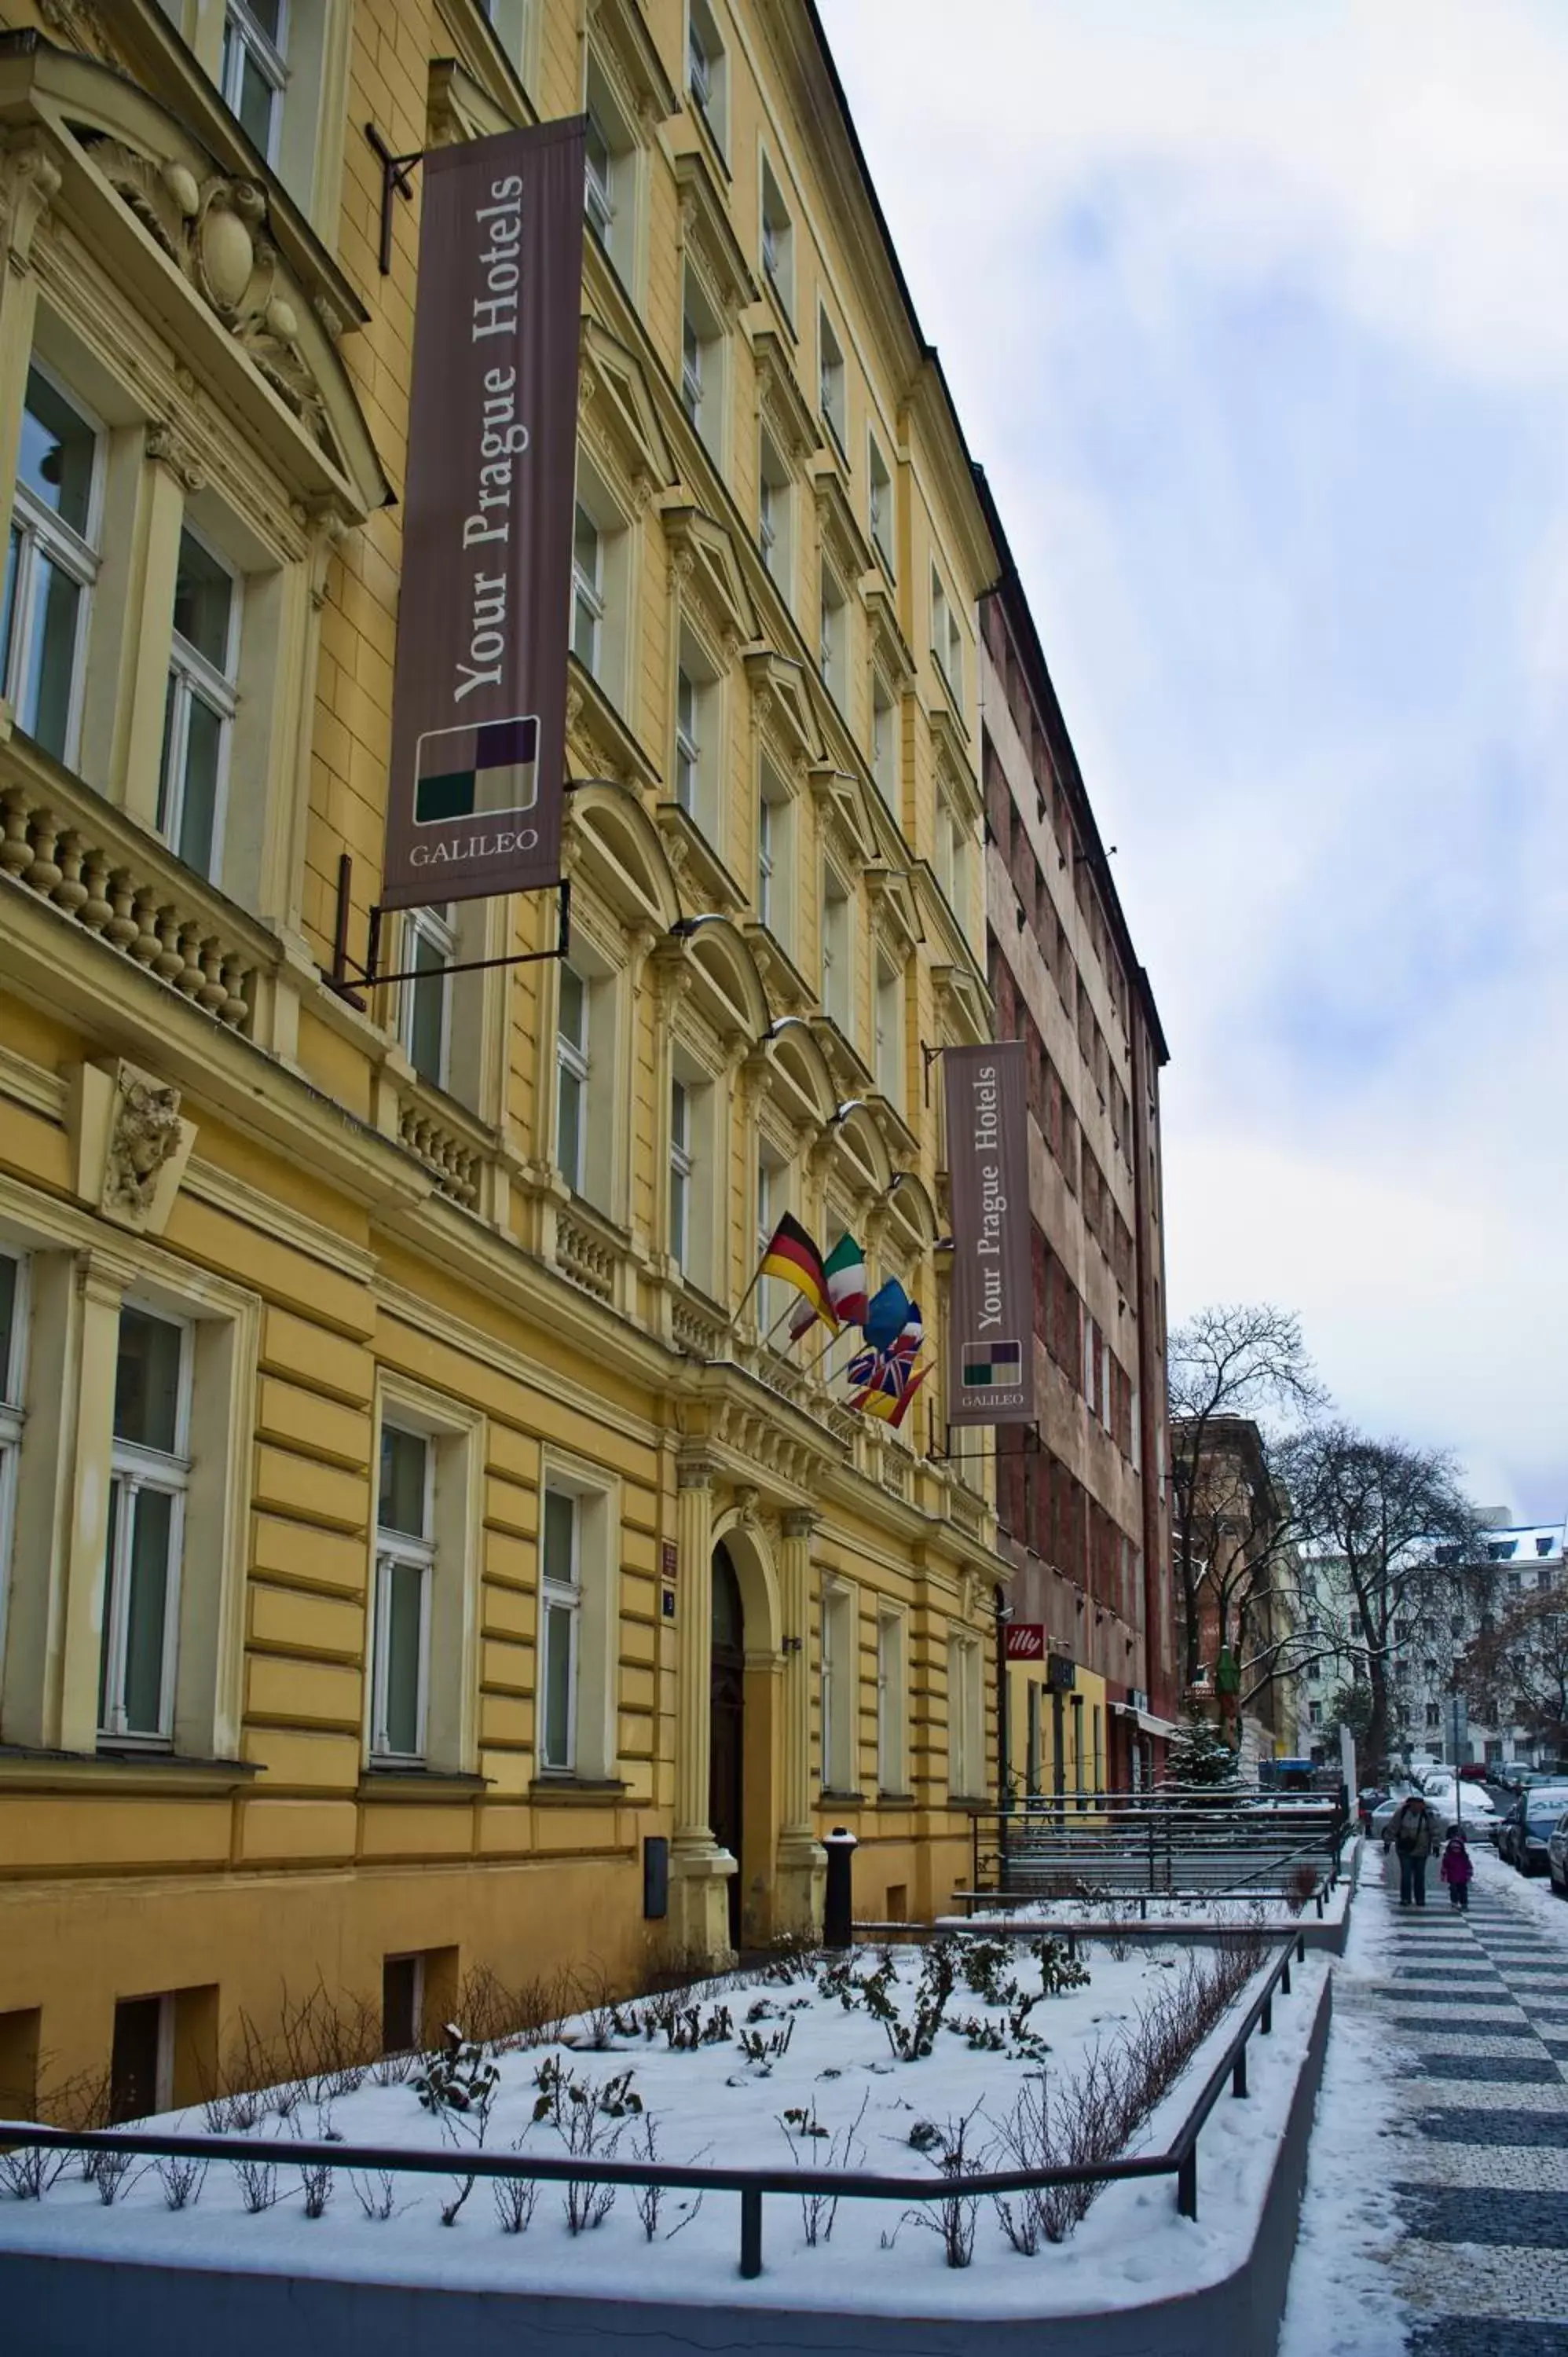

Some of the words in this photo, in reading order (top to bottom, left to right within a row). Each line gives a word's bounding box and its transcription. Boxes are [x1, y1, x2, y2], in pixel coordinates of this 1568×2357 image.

[473, 174, 522, 342] Hotels
[463, 366, 528, 549] Prague
[455, 573, 507, 703] Your
[409, 828, 539, 867] GALILEO
[973, 1066, 997, 1152] Hotels
[977, 1166, 1007, 1255] Prague
[977, 1267, 1002, 1330] Your
[962, 1393, 1024, 1407] GALILEO
[1008, 1629, 1041, 1656] illy
